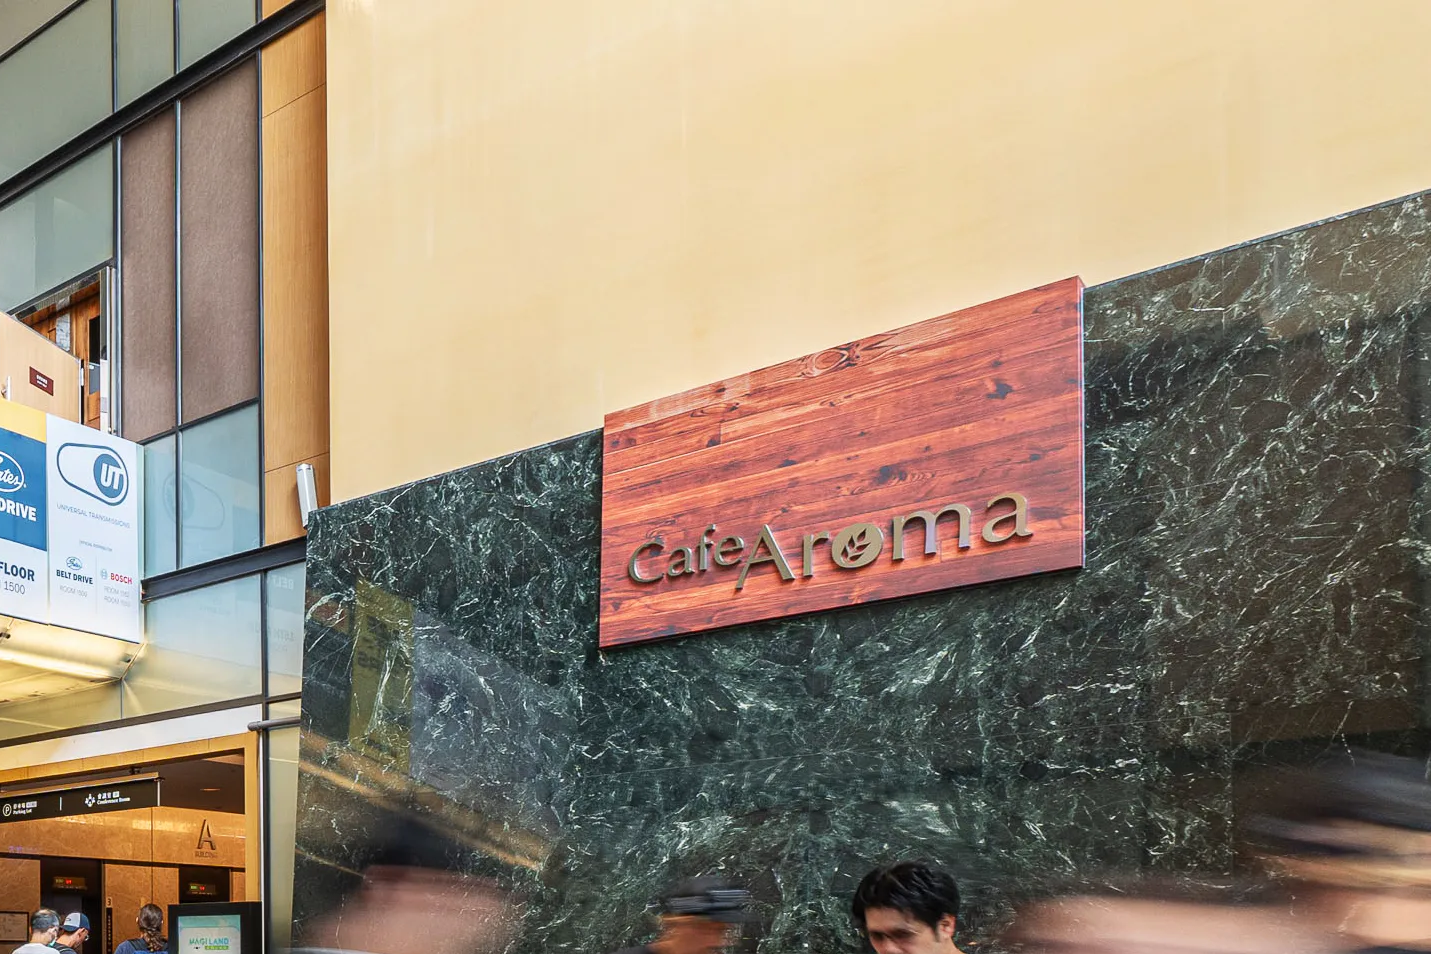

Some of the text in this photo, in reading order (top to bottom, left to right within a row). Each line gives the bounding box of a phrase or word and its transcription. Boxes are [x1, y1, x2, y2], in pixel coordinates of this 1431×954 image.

[100, 462, 124, 490] UT
[56, 569, 94, 585] BELT DRIVE
[110, 572, 133, 585] BOSCH
[3, 580, 26, 595] 1500
[197, 819, 216, 850] A
